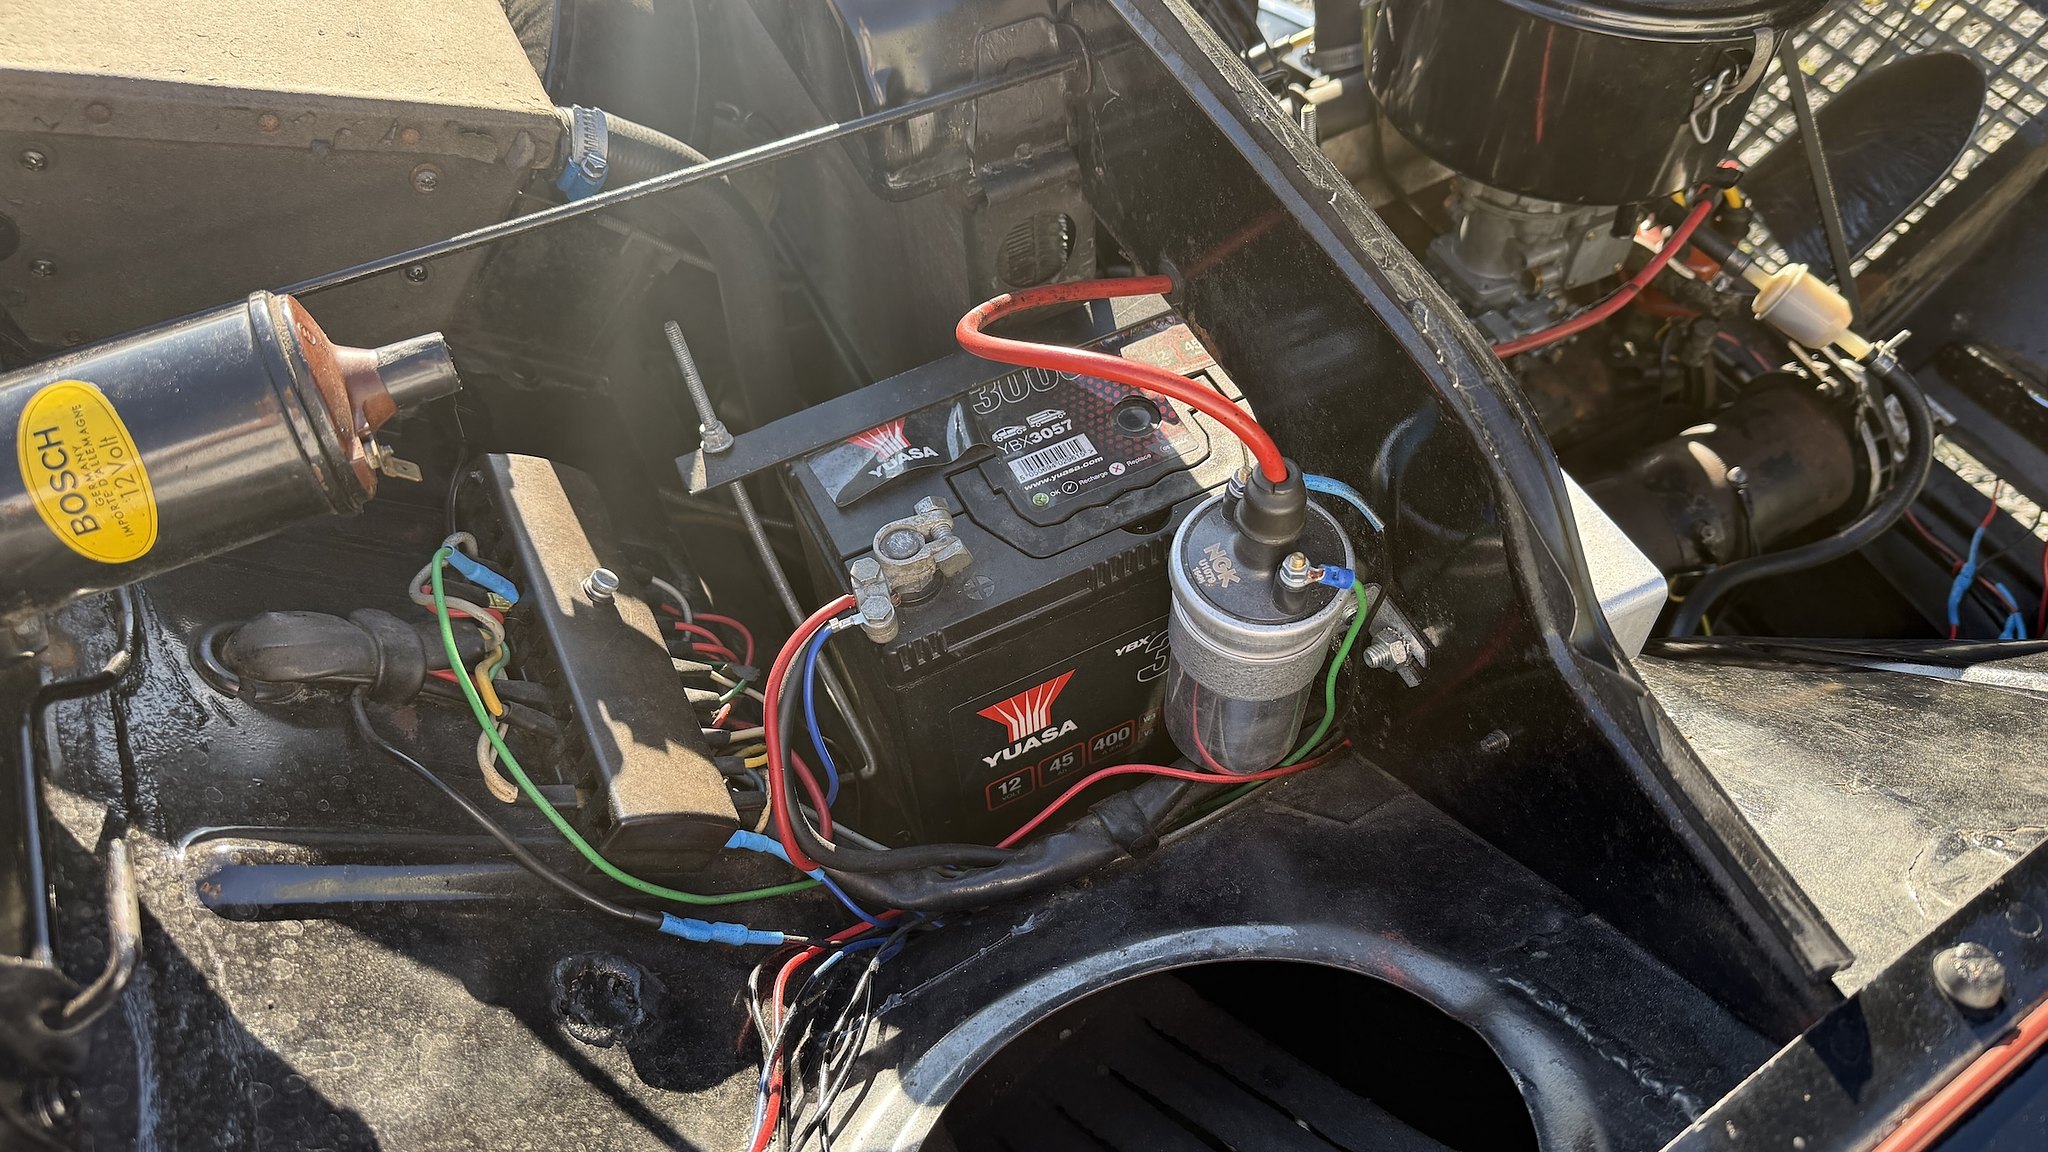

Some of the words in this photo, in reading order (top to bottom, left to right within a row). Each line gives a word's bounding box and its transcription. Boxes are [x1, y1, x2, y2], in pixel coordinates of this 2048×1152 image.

[71, 404, 109, 488] D'ALLEMAGNE
[997, 418, 1073, 455] YBX3057
[99, 435, 124, 476] Volt
[868, 446, 939, 478] YUASA
[1126, 452, 1152, 467] Replace
[33, 426, 101, 536] BOSCH
[72, 446, 105, 507] GERMANY
[115, 473, 140, 500] 12
[1023, 456, 1105, 491] www.yuasa.com
[1078, 470, 1109, 487] Recharge
[1049, 488, 1061, 498] OK
[103, 491, 135, 538] IMPORTE
[1203, 542, 1241, 588] NGK
[1115, 635, 1151, 657] YBX
[982, 719, 1079, 768] YUASA
[1093, 726, 1130, 752] 400
[1049, 752, 1074, 773] 45
[998, 776, 1022, 795] 12
[1001, 790, 1021, 801] VOLT
